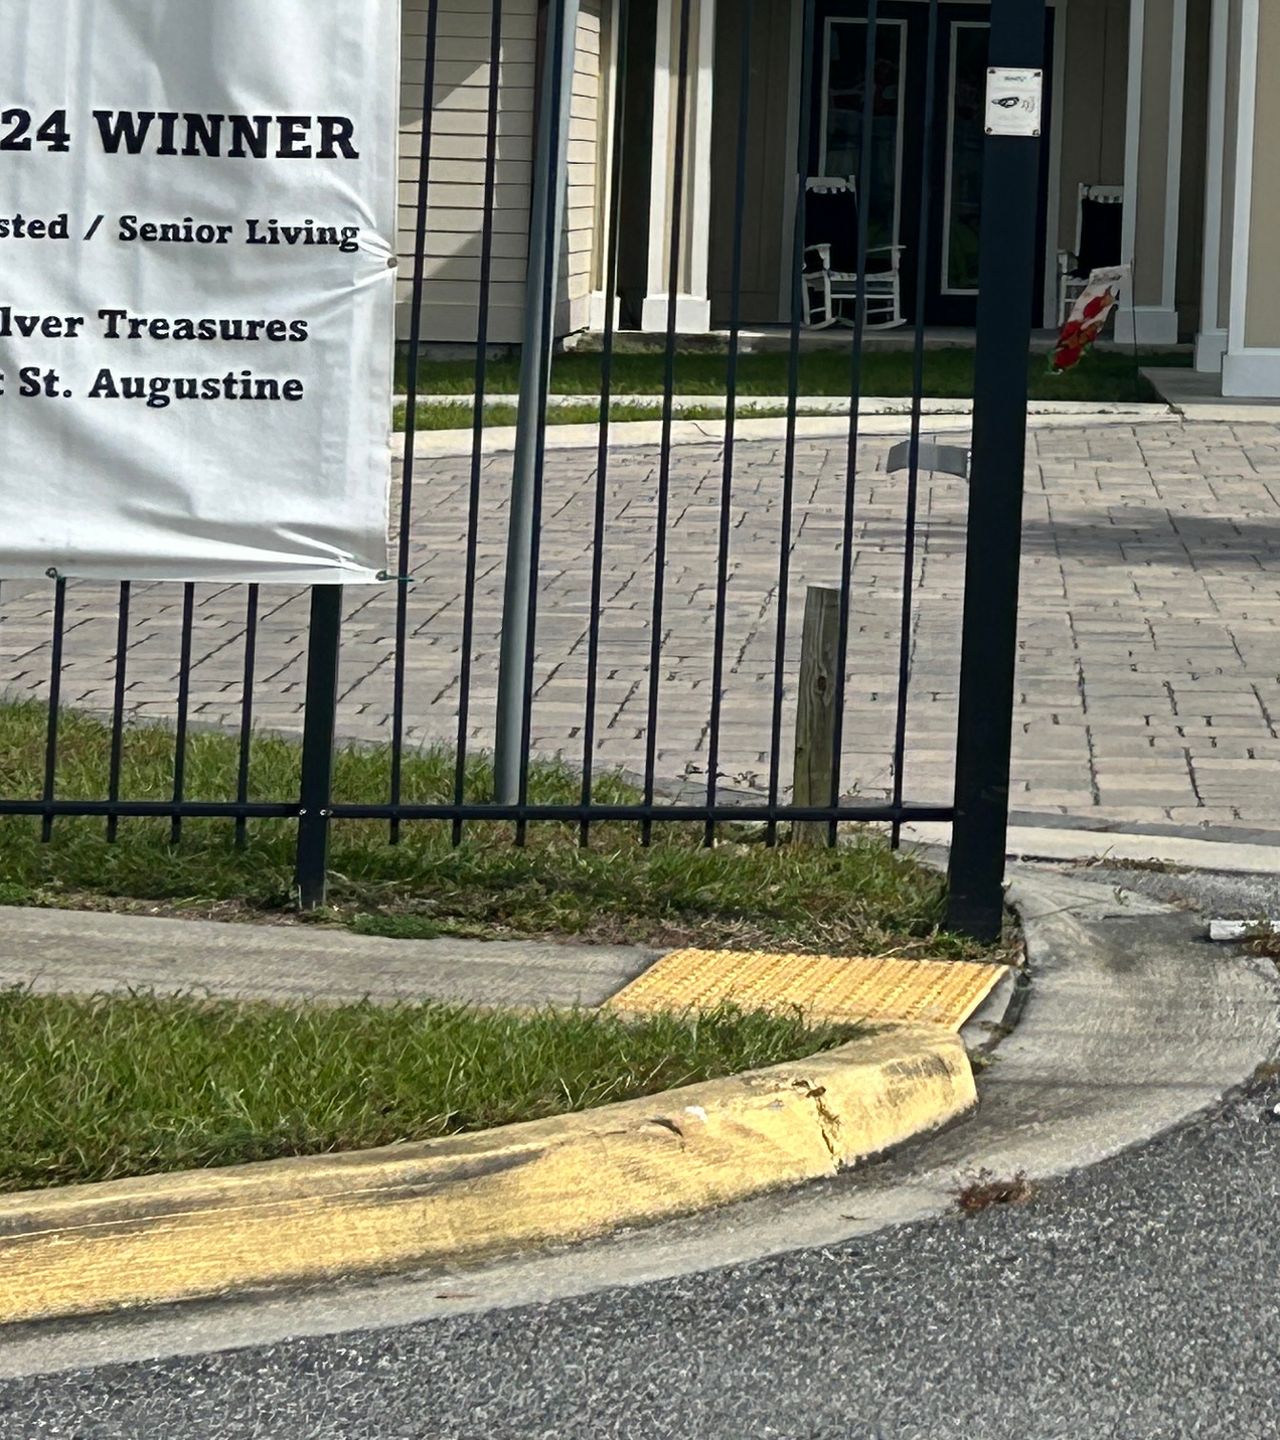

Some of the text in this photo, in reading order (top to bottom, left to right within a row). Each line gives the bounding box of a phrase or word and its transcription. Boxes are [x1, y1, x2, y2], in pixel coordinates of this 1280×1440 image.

[0, 108, 360, 159] 24 WINNER
[0, 213, 360, 252] sted / Senior Living
[0, 306, 309, 342] lver Treasures
[19, 366, 72, 398] St.
[88, 368, 304, 408] Augustine
